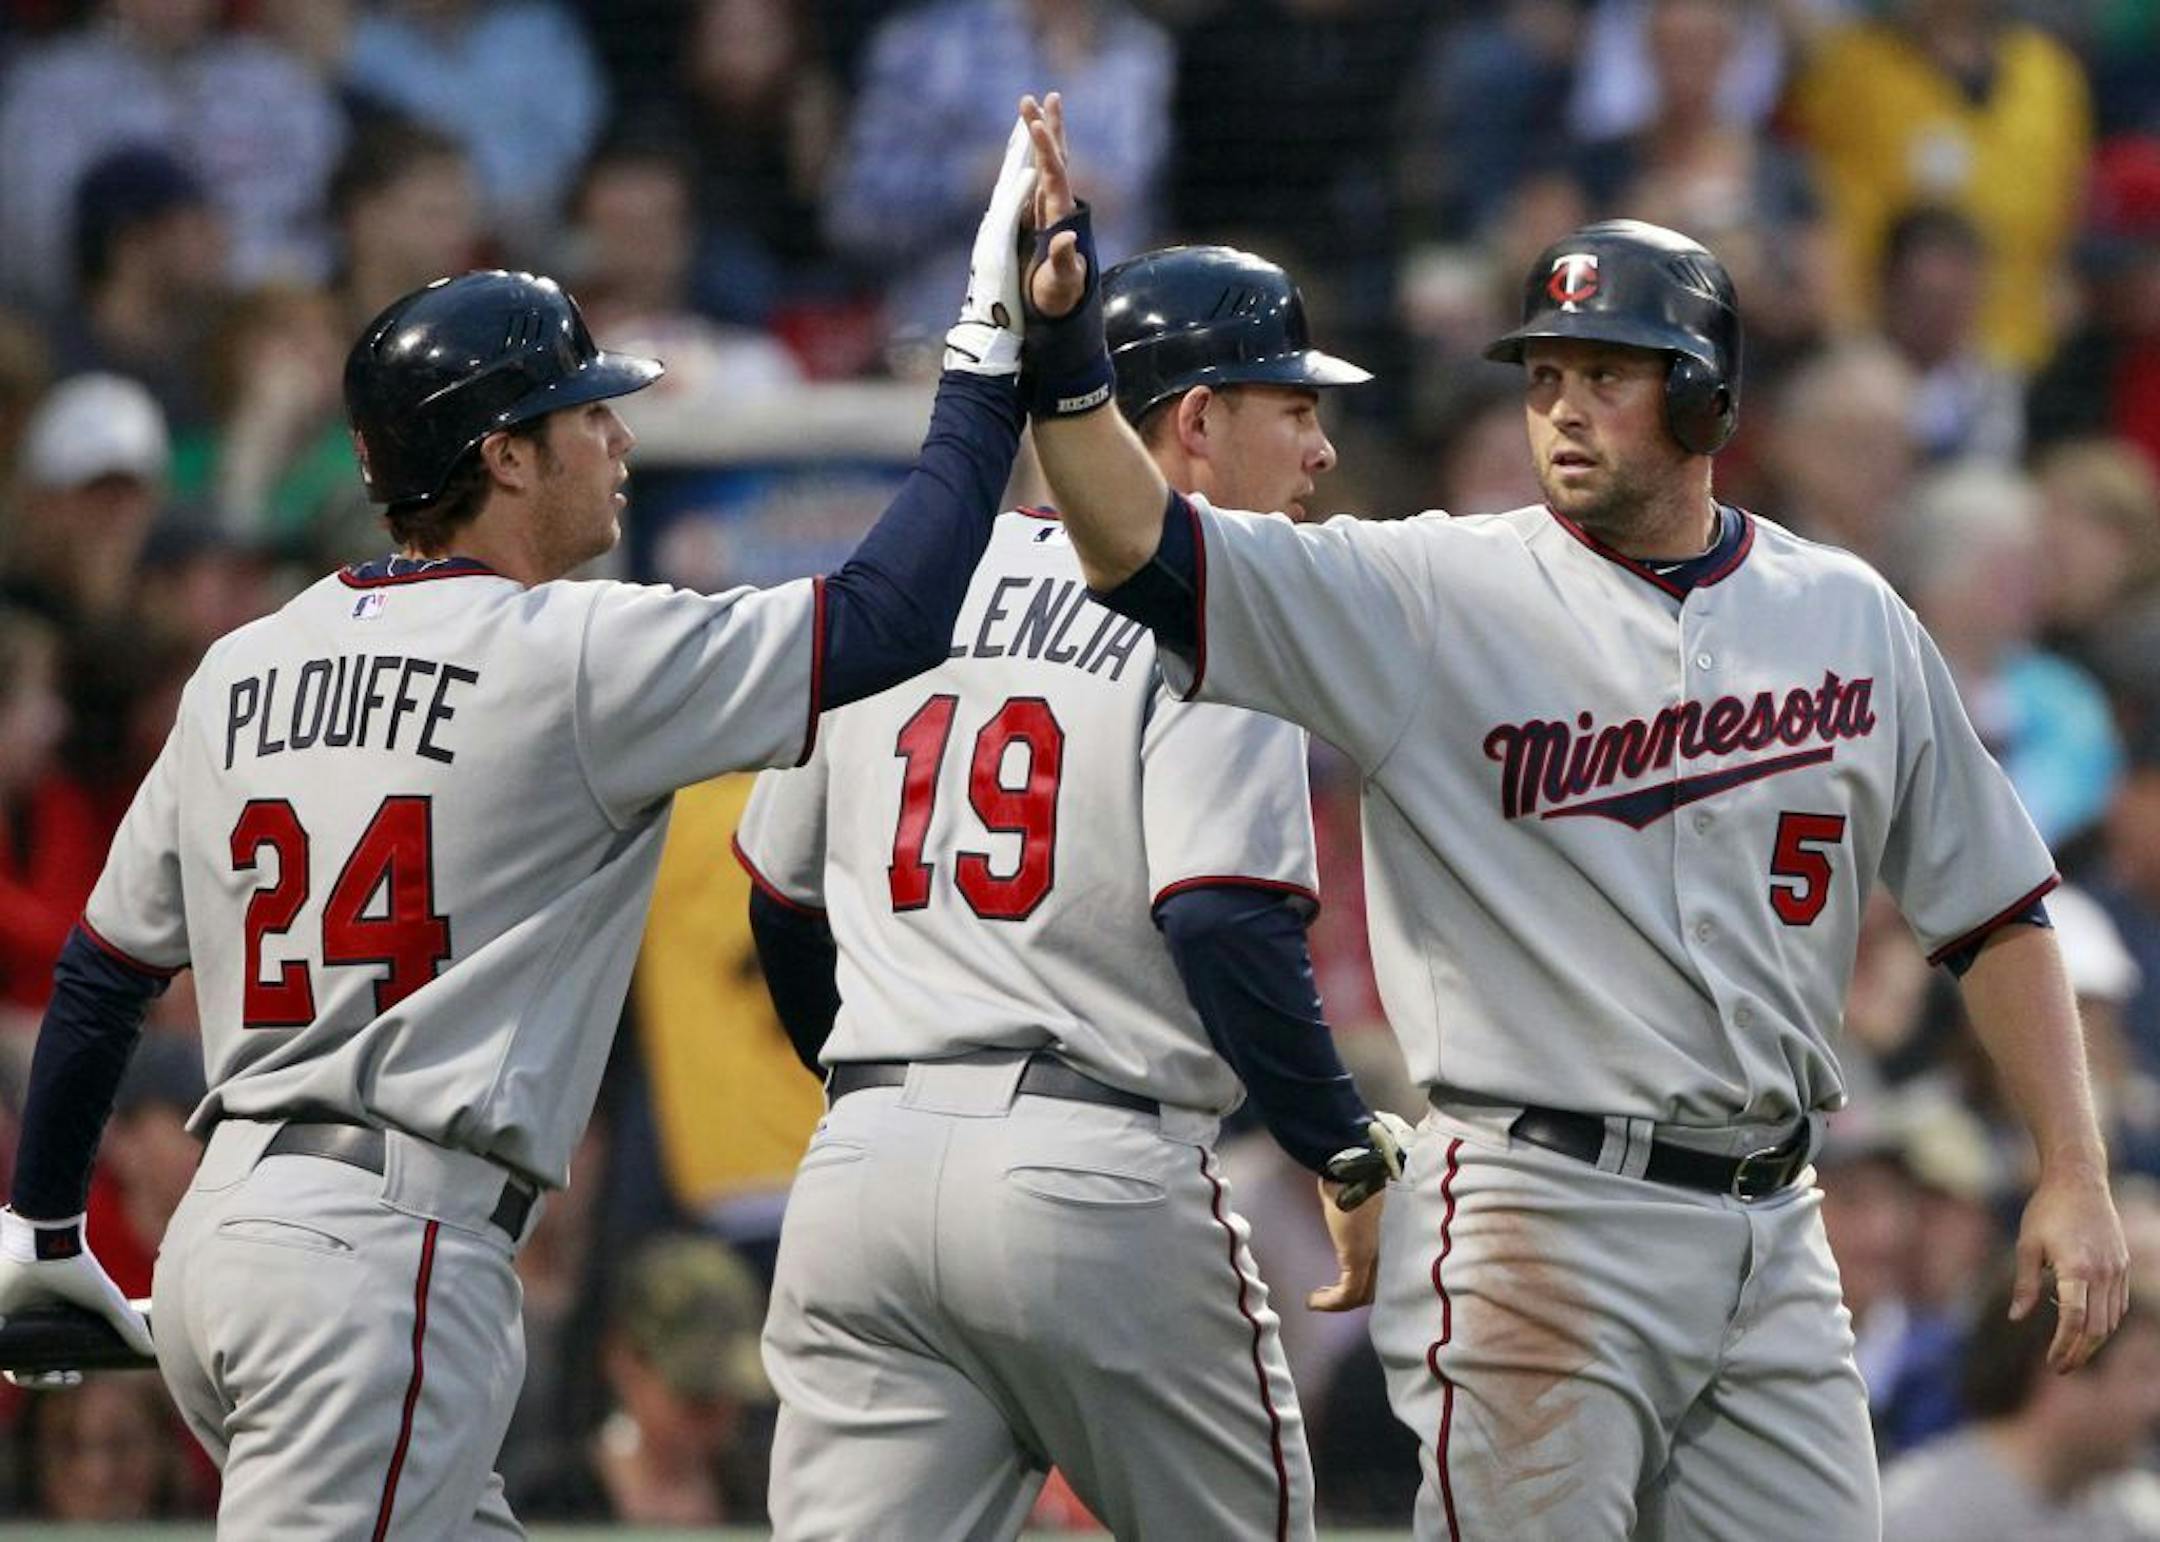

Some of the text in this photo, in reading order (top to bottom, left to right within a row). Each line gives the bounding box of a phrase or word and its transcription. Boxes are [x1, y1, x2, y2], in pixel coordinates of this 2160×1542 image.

[225, 654, 479, 770] PLOUFFE
[1483, 670, 1876, 820] Minnesota
[888, 694, 1065, 921] 19
[1770, 811, 1846, 926] 5
[230, 795, 451, 1029] 24
